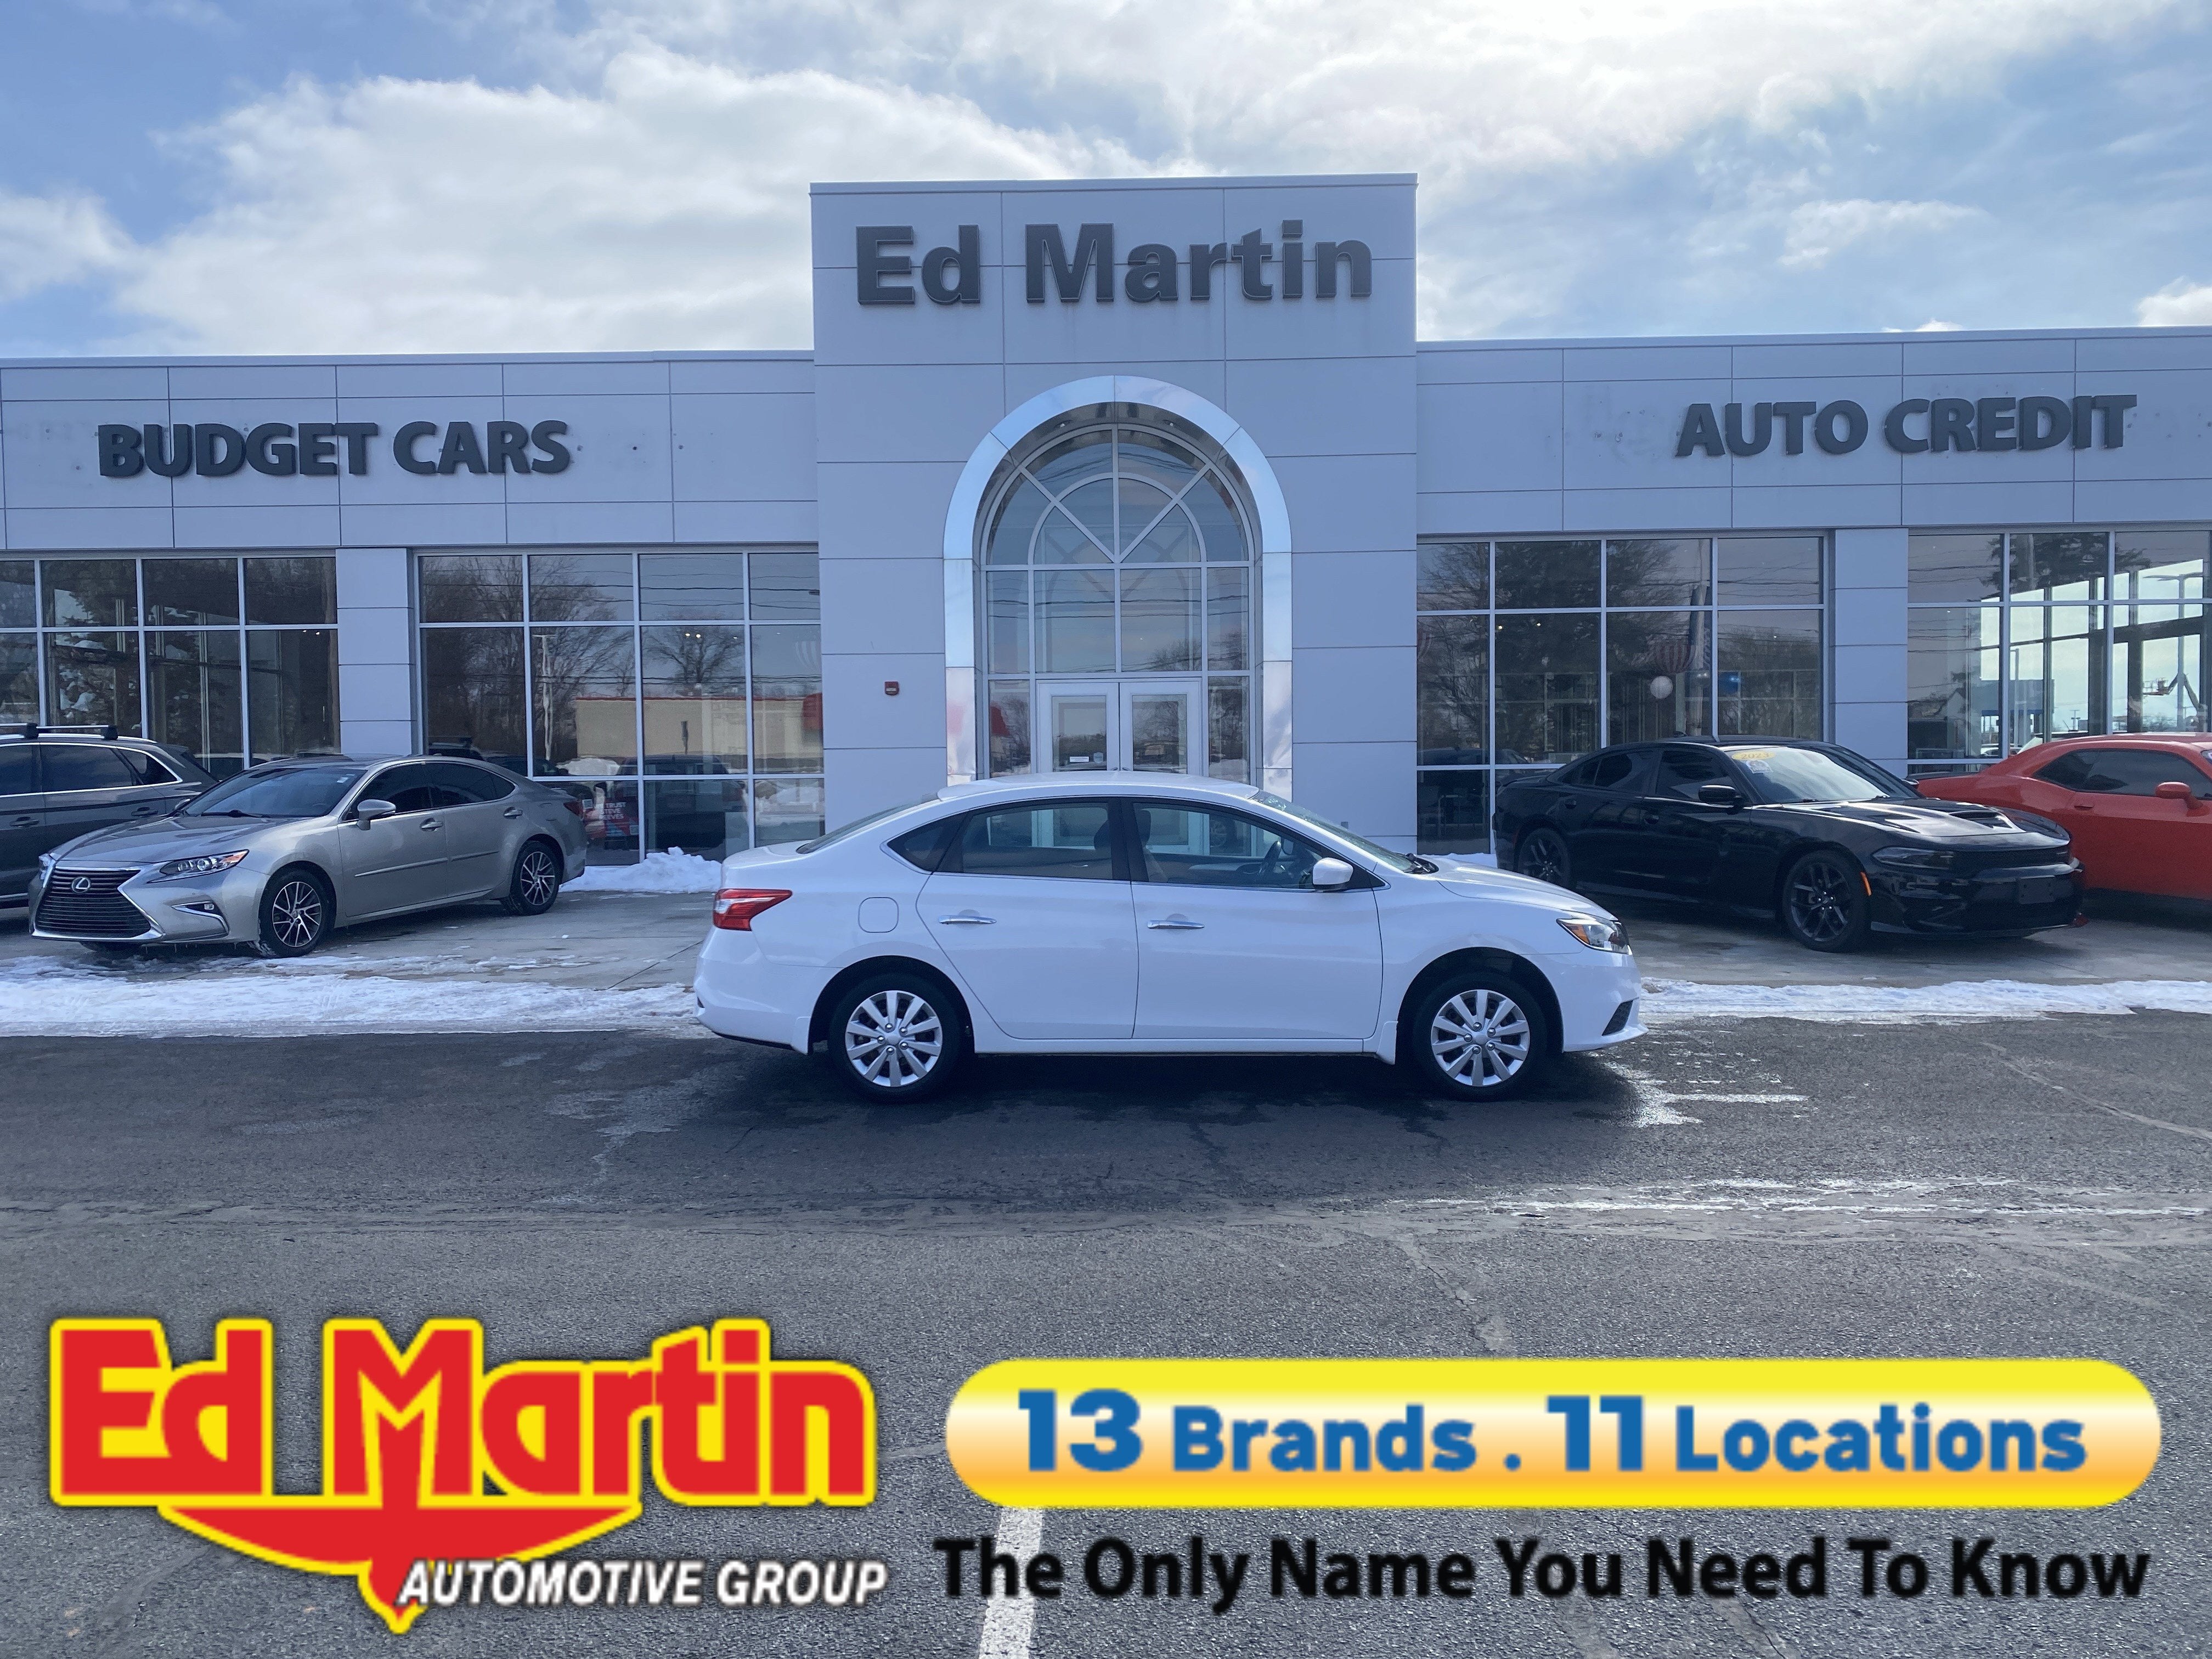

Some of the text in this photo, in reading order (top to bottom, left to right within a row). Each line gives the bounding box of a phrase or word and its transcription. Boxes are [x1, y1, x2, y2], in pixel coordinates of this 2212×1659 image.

[856, 220, 1372, 307] Ed Martin
[98, 420, 571, 478] BUDGET CARS
[1675, 394, 2138, 458] AUTO CREDIT
